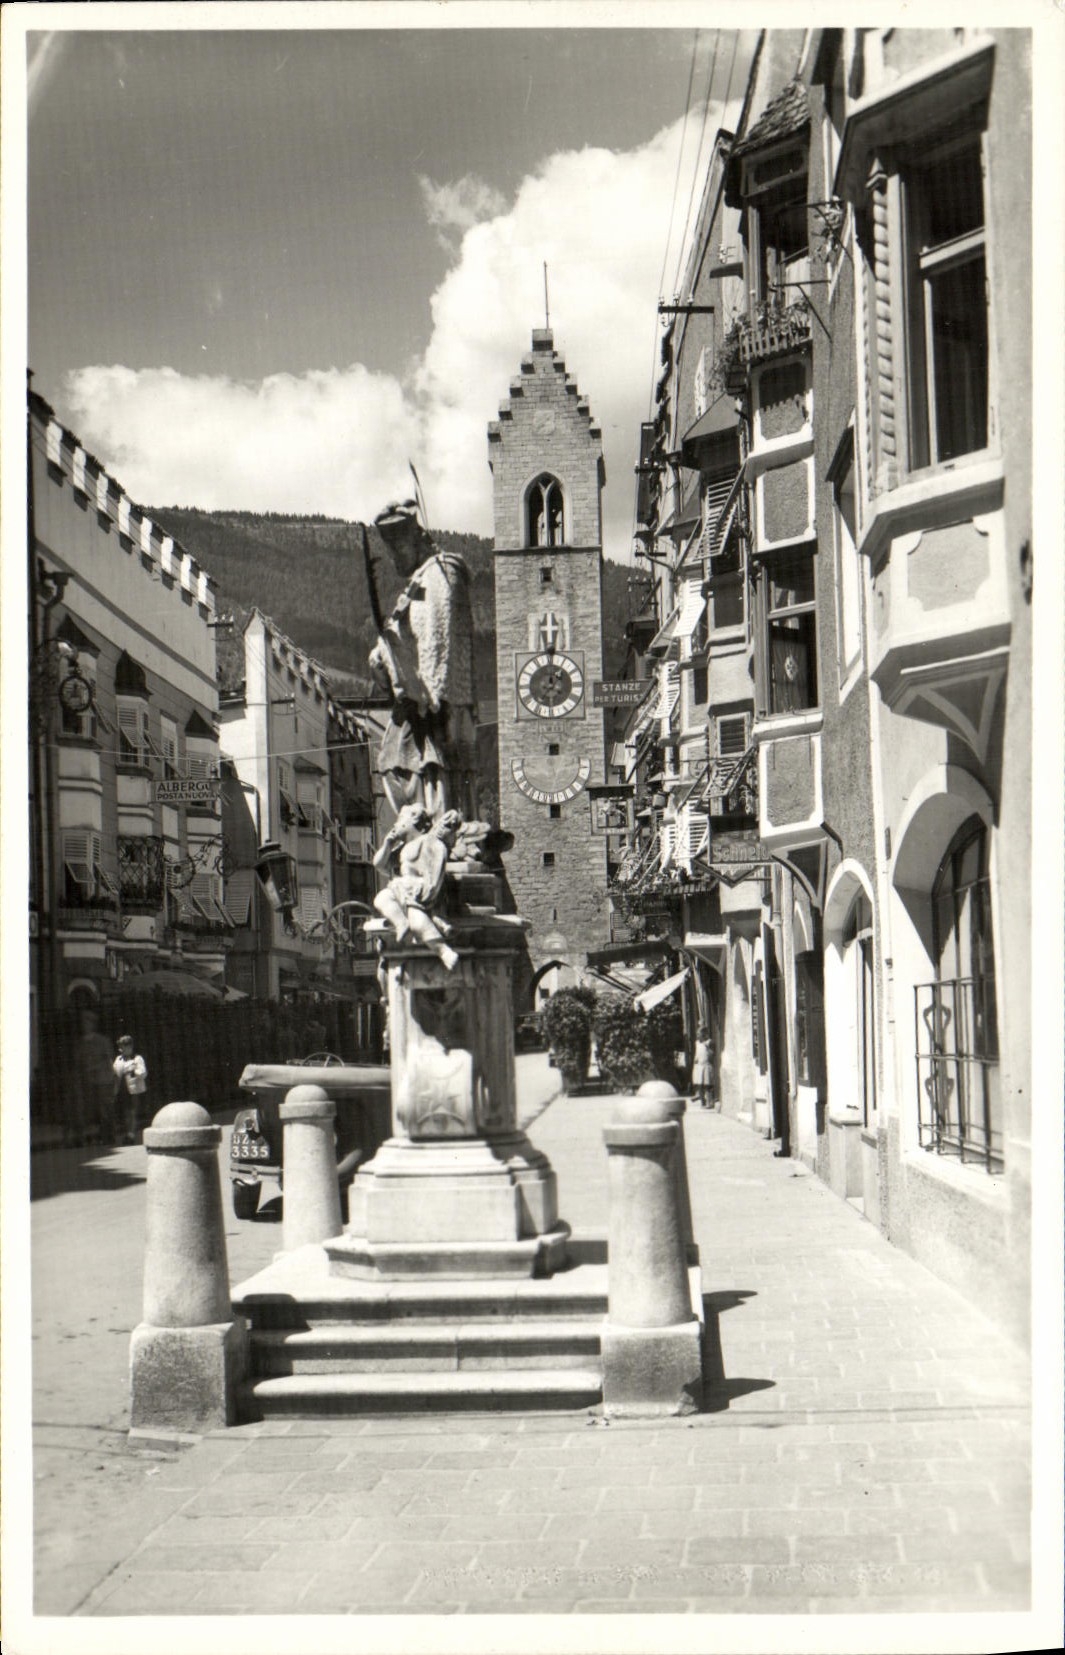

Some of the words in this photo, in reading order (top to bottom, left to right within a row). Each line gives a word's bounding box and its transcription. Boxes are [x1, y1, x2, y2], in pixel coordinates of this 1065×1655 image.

[602, 683, 641, 692] STANZE
[157, 792, 184, 800] POSTA
[231, 1145, 269, 1158] 3335
